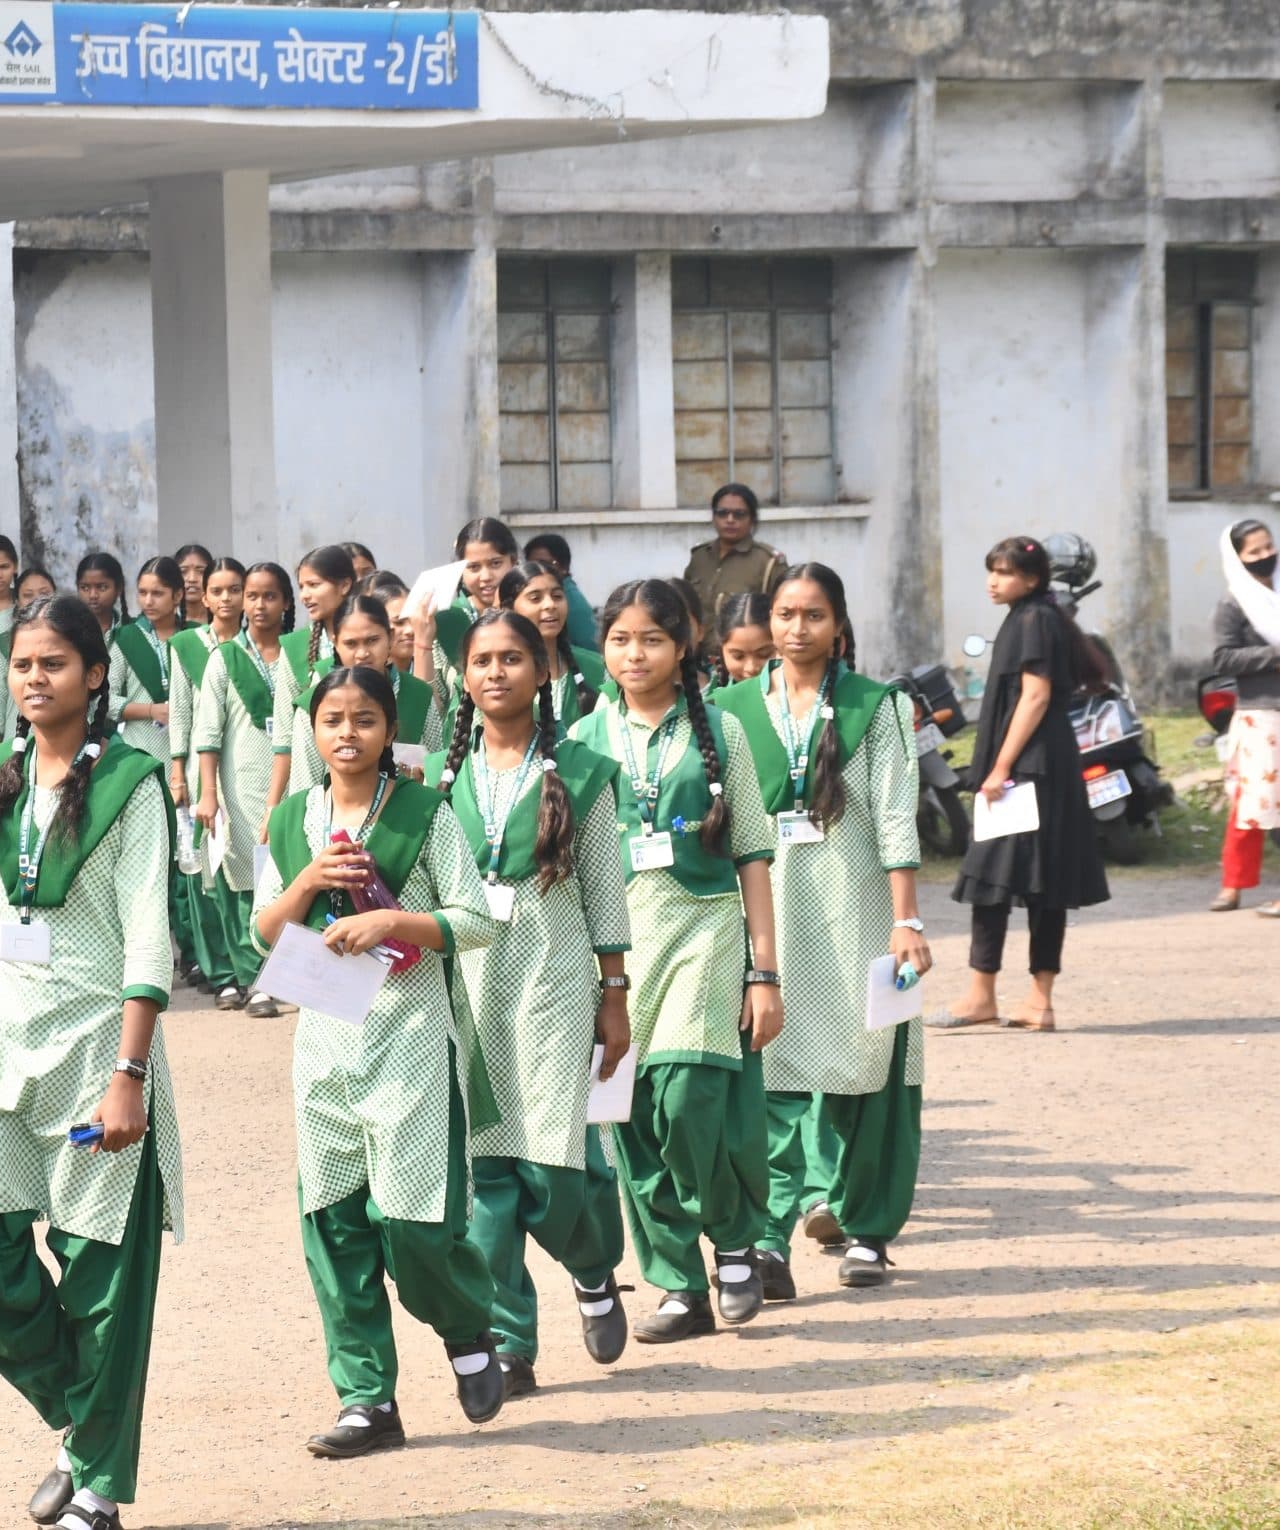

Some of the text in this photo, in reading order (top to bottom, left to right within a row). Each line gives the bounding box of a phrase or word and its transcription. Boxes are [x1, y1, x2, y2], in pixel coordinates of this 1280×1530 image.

[70, 34, 131, 79] उच्च
[135, 22, 268, 90] विद्यालय,
[273, 27, 367, 84] सेक्टर
